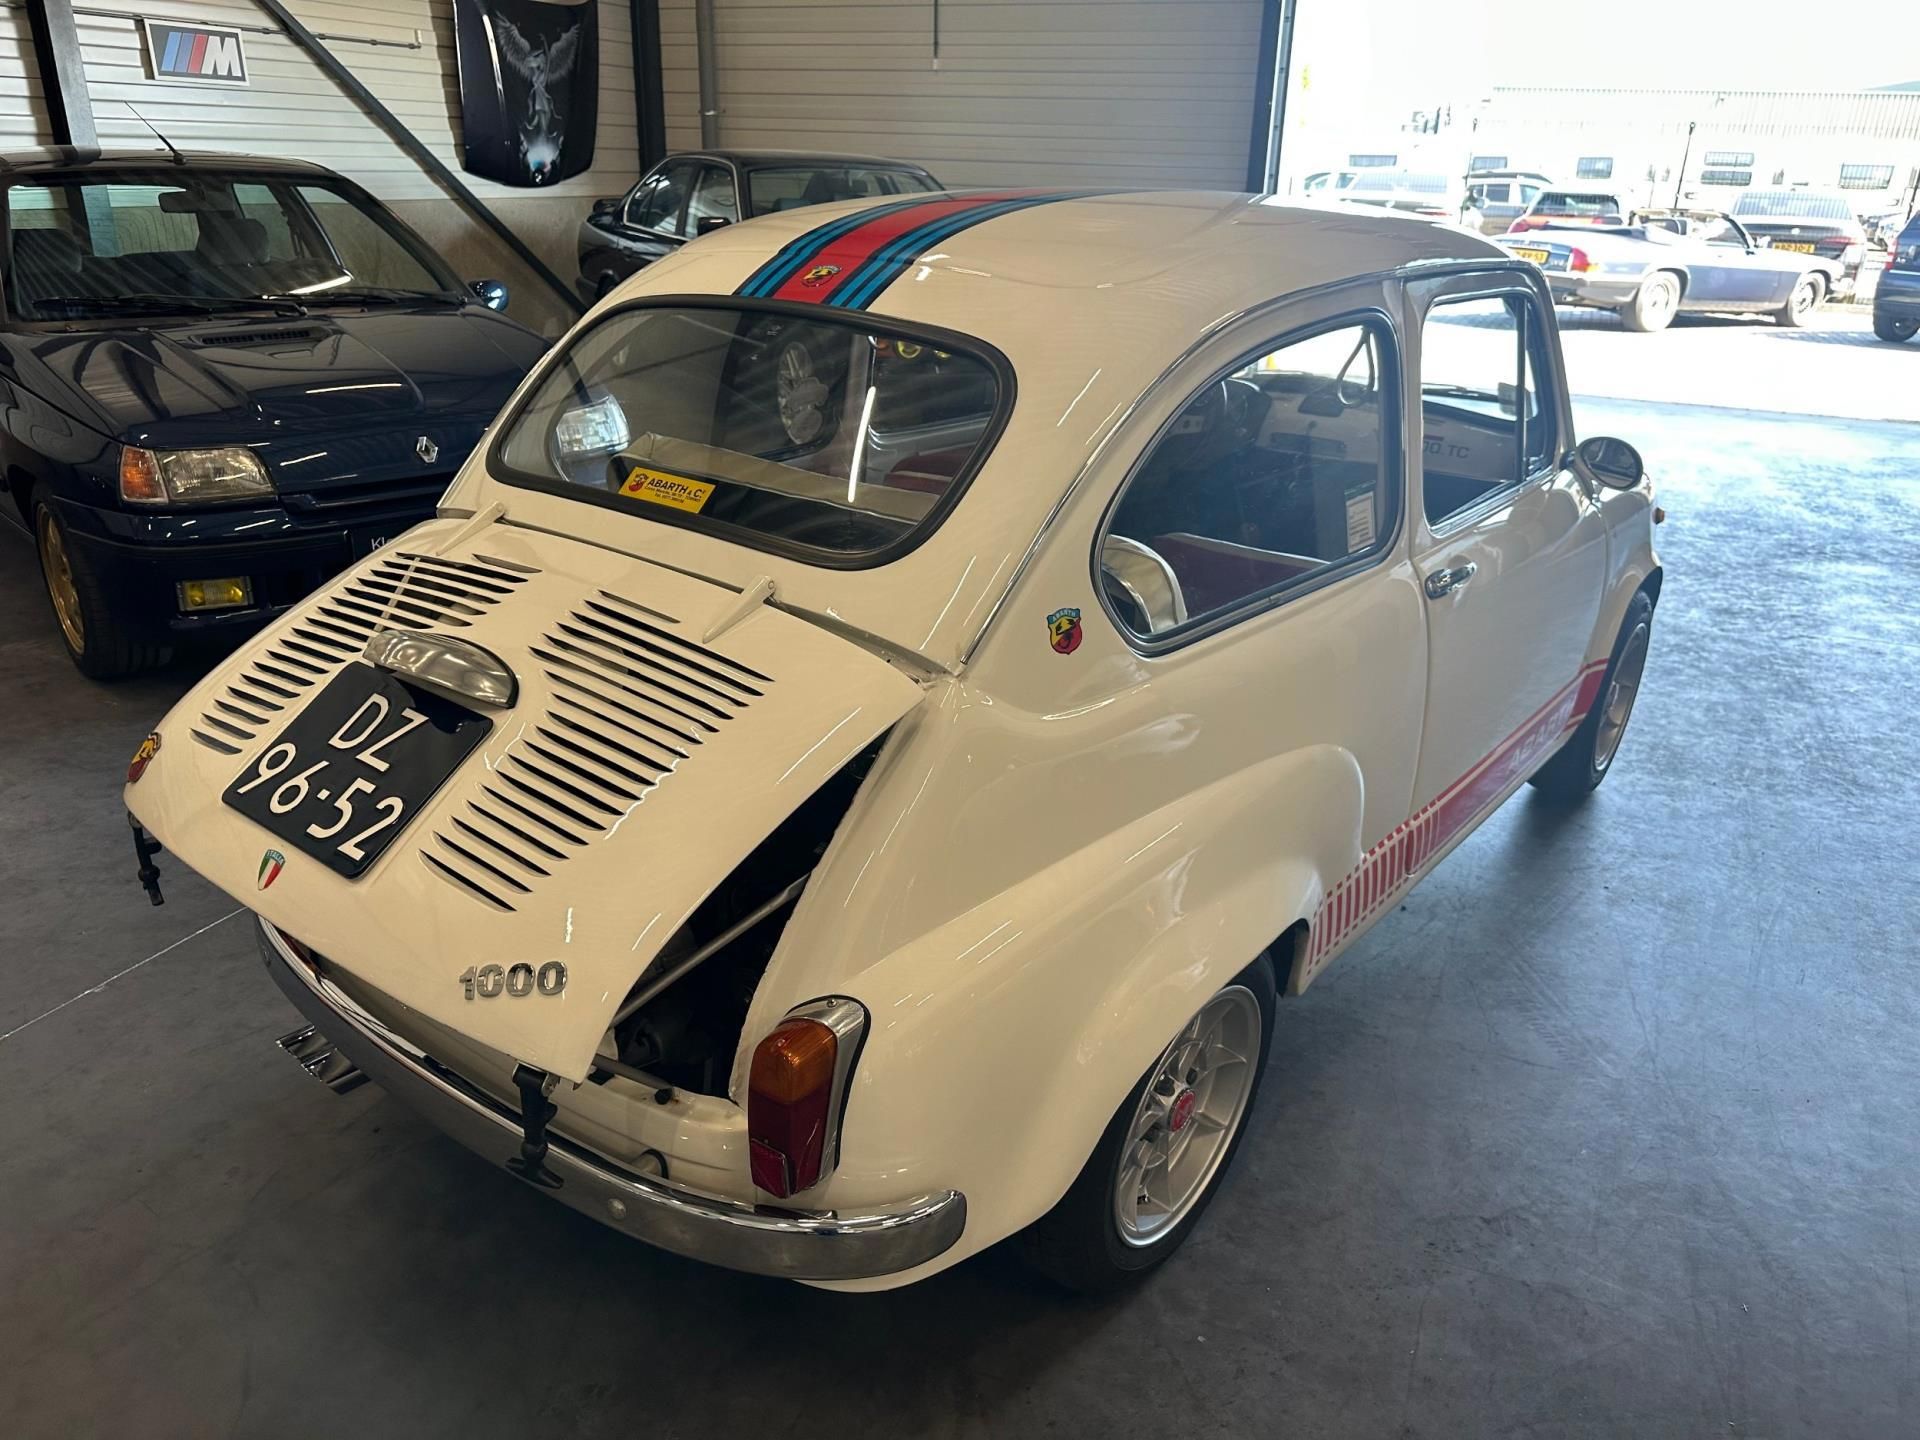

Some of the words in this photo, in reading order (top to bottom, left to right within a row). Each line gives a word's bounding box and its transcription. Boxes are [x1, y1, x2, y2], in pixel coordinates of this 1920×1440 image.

[648, 478, 689, 495] ABARTH
[328, 692, 430, 772] DZ
[458, 960, 568, 1001] 1000
